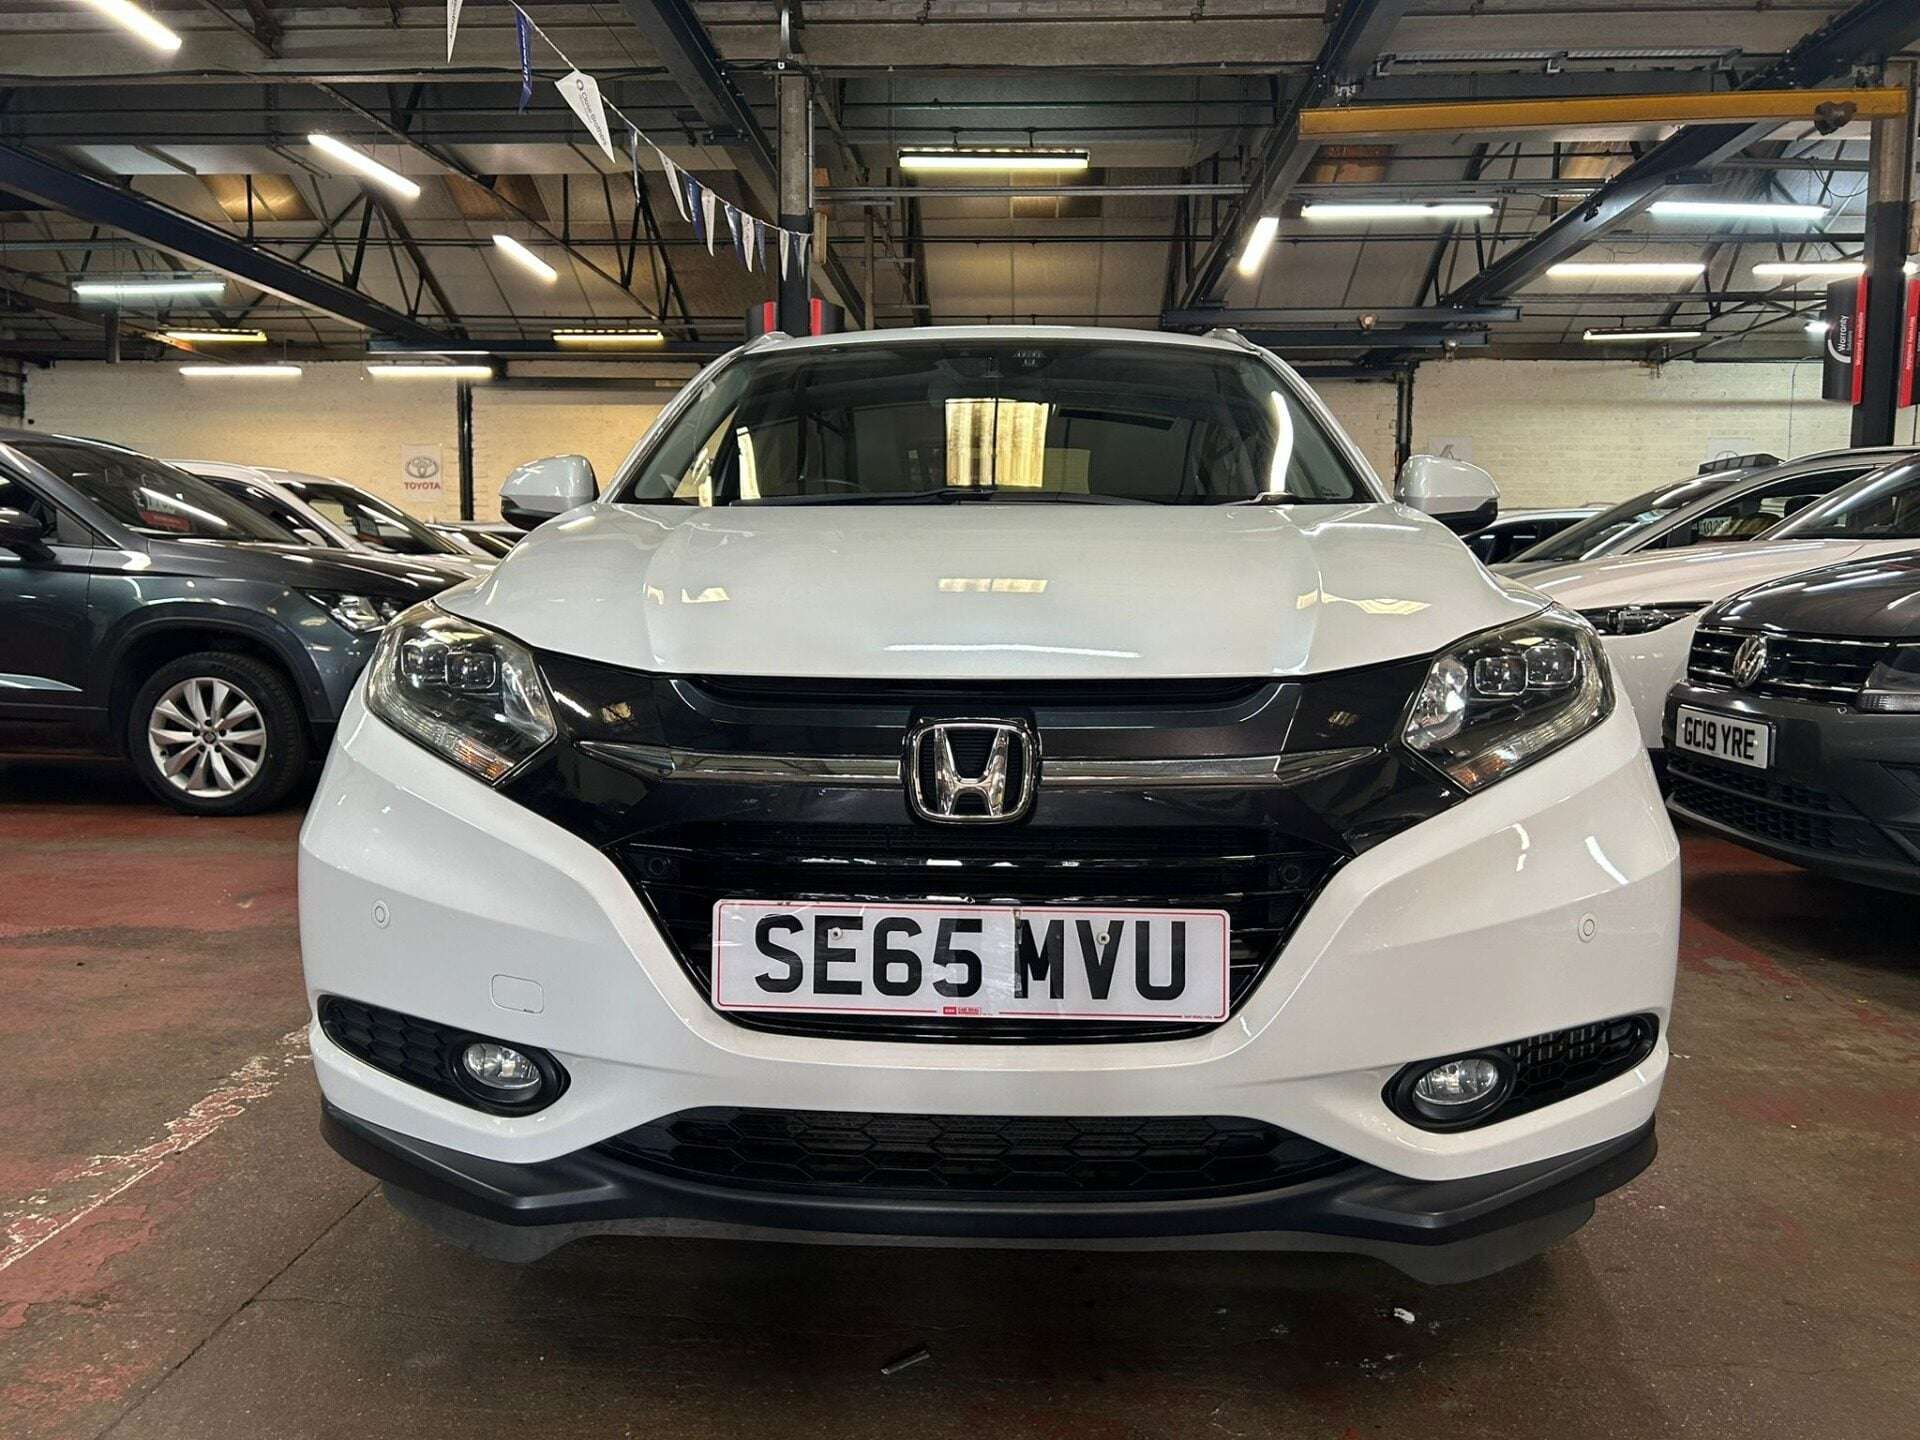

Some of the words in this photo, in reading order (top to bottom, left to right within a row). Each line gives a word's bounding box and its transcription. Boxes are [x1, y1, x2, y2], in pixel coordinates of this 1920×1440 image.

[581, 91, 593, 114] Close
[1837, 314, 1850, 352] Warranty
[403, 481, 442, 490] TOYOTA
[1684, 716, 1717, 751] GC19
[1721, 723, 1756, 761] YRE
[754, 913, 983, 998] SE65
[1014, 918, 1186, 1001] MVU
